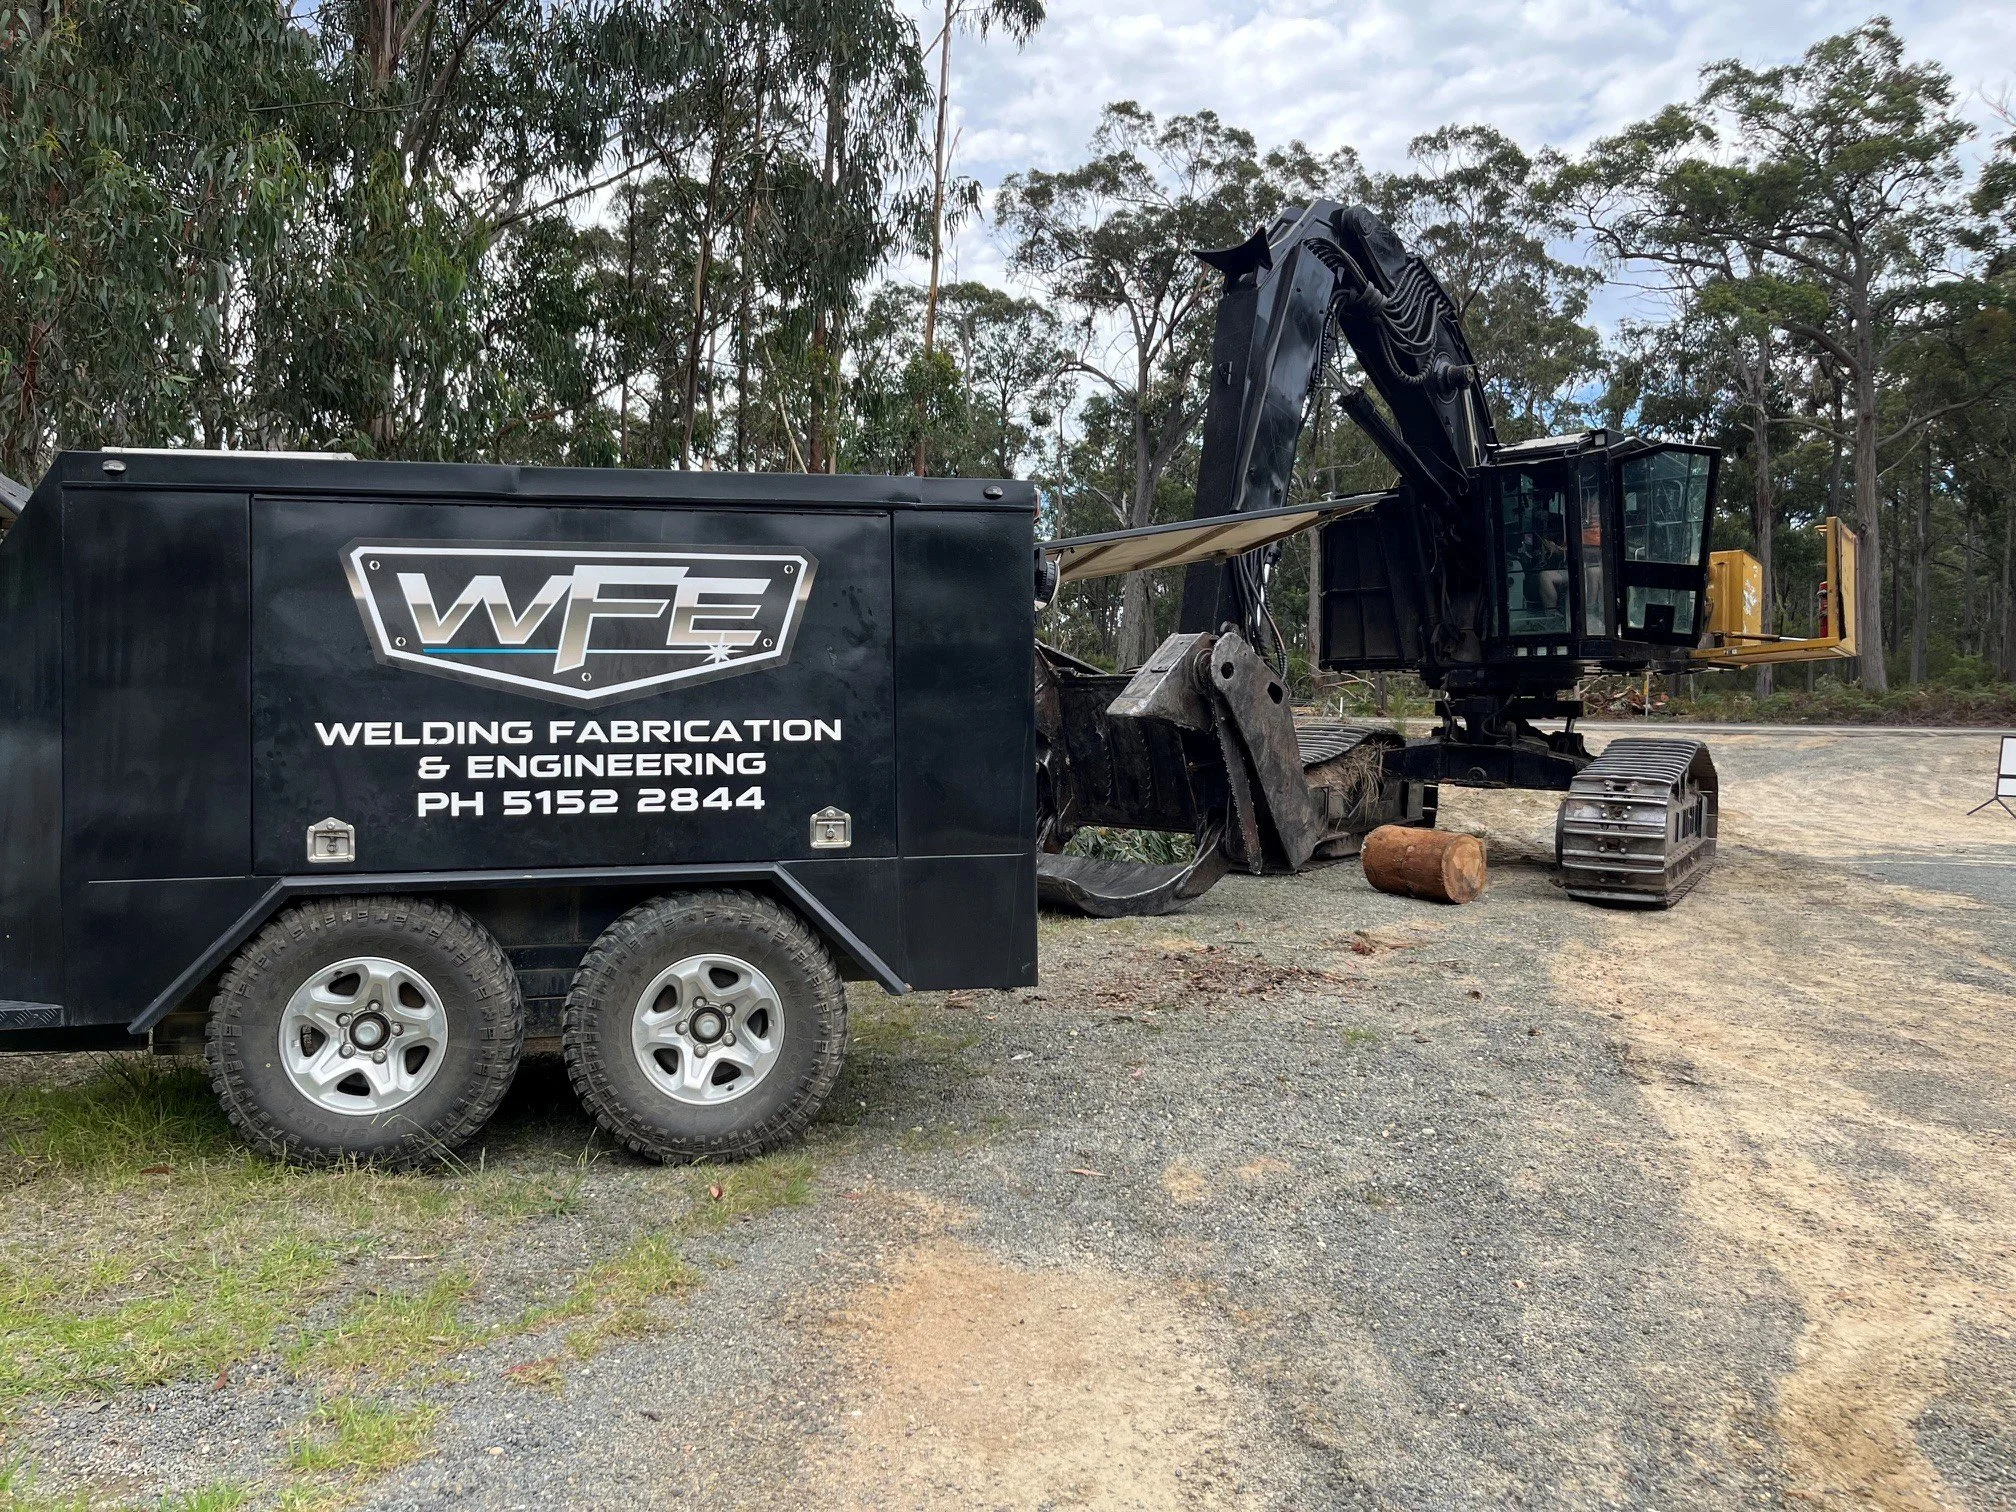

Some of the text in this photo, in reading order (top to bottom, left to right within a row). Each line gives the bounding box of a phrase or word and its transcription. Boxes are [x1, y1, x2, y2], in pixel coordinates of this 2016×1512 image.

[396, 565, 772, 674] WFE
[315, 719, 841, 746] WELDING FABRICATION
[418, 753, 766, 779] & ENGINEERING
[418, 787, 766, 817] PH 5152 2844
